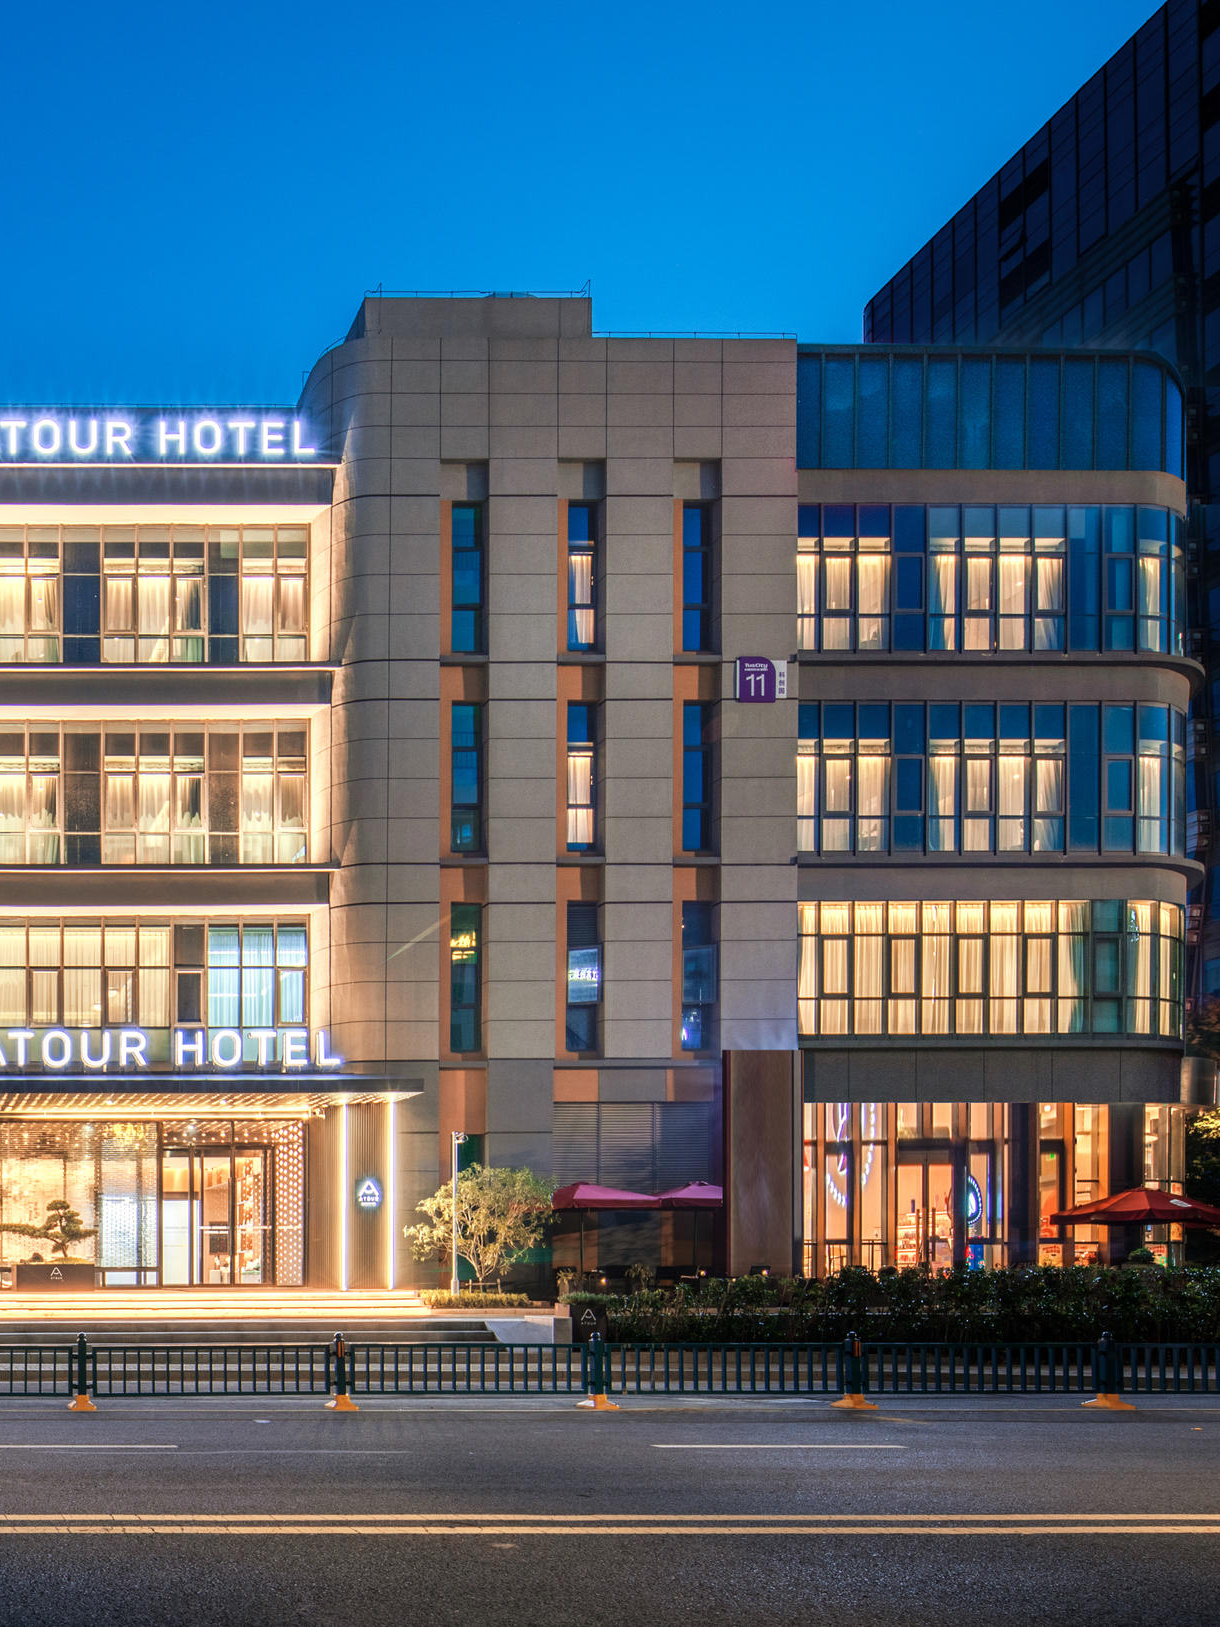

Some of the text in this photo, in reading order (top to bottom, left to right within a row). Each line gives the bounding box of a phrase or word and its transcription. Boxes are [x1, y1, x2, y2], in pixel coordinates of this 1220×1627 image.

[159, 420, 315, 456] HOTEL
[746, 674, 765, 697] 11
[175, 1031, 341, 1067] HOTEL
